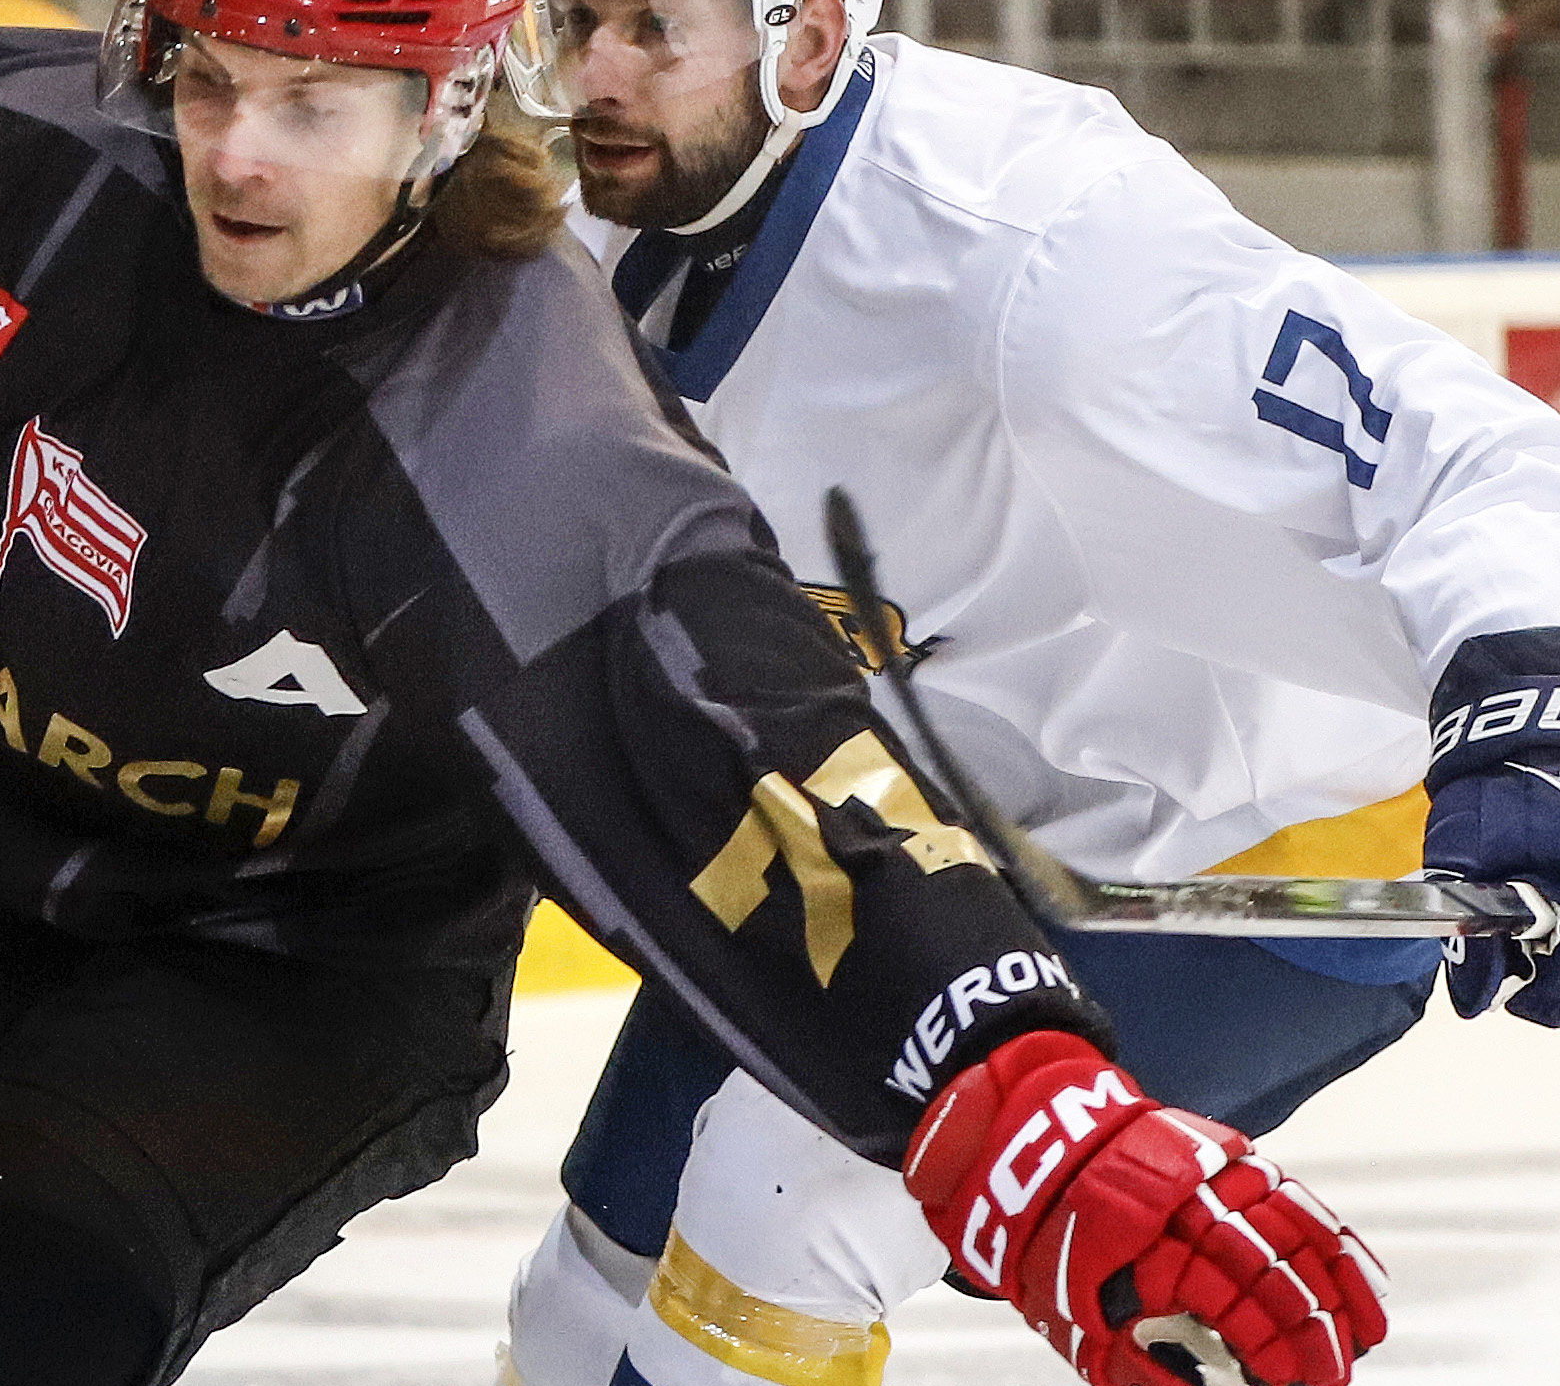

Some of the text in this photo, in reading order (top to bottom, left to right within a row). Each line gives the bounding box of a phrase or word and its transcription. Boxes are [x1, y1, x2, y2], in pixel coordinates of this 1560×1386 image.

[1251, 308, 1393, 491] 17
[202, 628, 370, 717] A
[885, 950, 1080, 1104] WERON
[961, 1069, 1145, 1288] CCM
